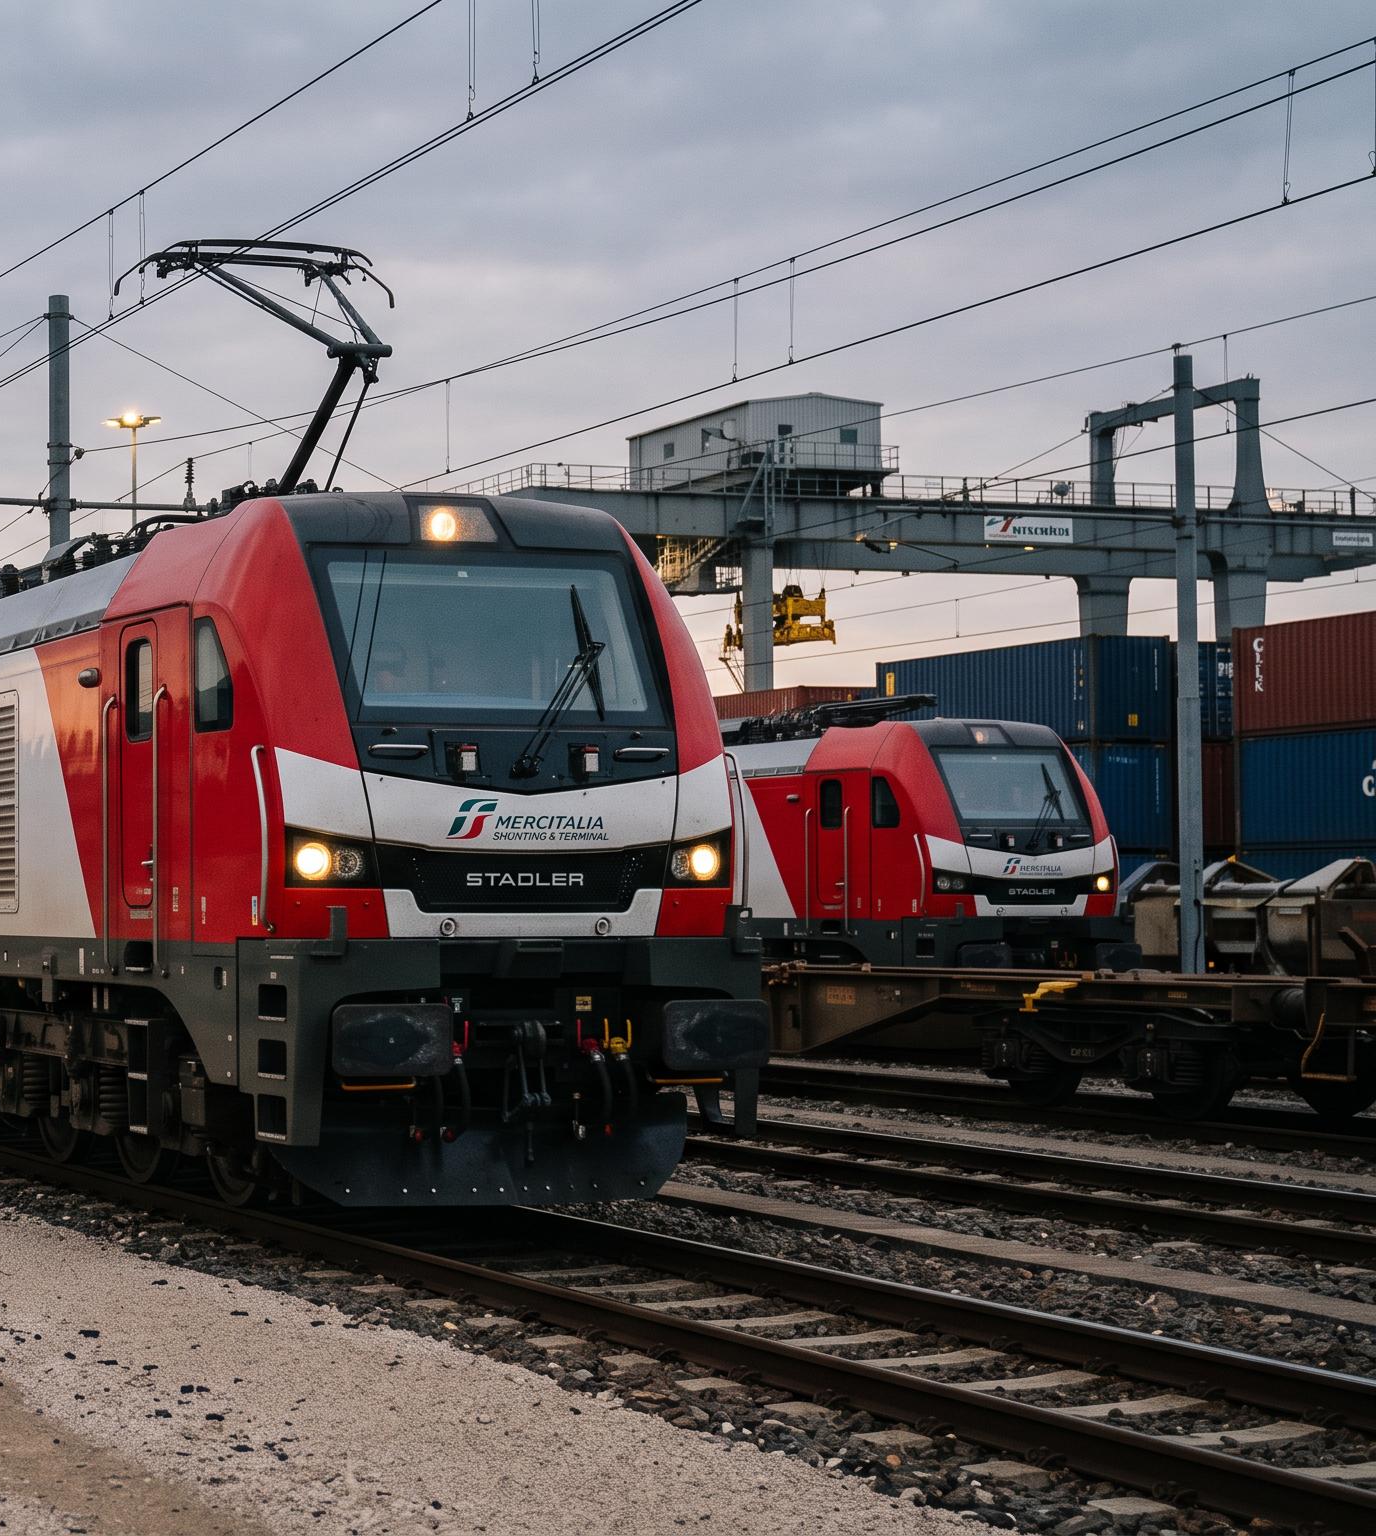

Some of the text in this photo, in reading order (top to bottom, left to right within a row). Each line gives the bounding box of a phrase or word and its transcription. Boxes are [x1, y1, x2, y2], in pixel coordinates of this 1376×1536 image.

[495, 816, 604, 829] MERCITALIA
[492, 832, 609, 841] SHUNTING & TERMINAL
[466, 873, 584, 886] STADLER
